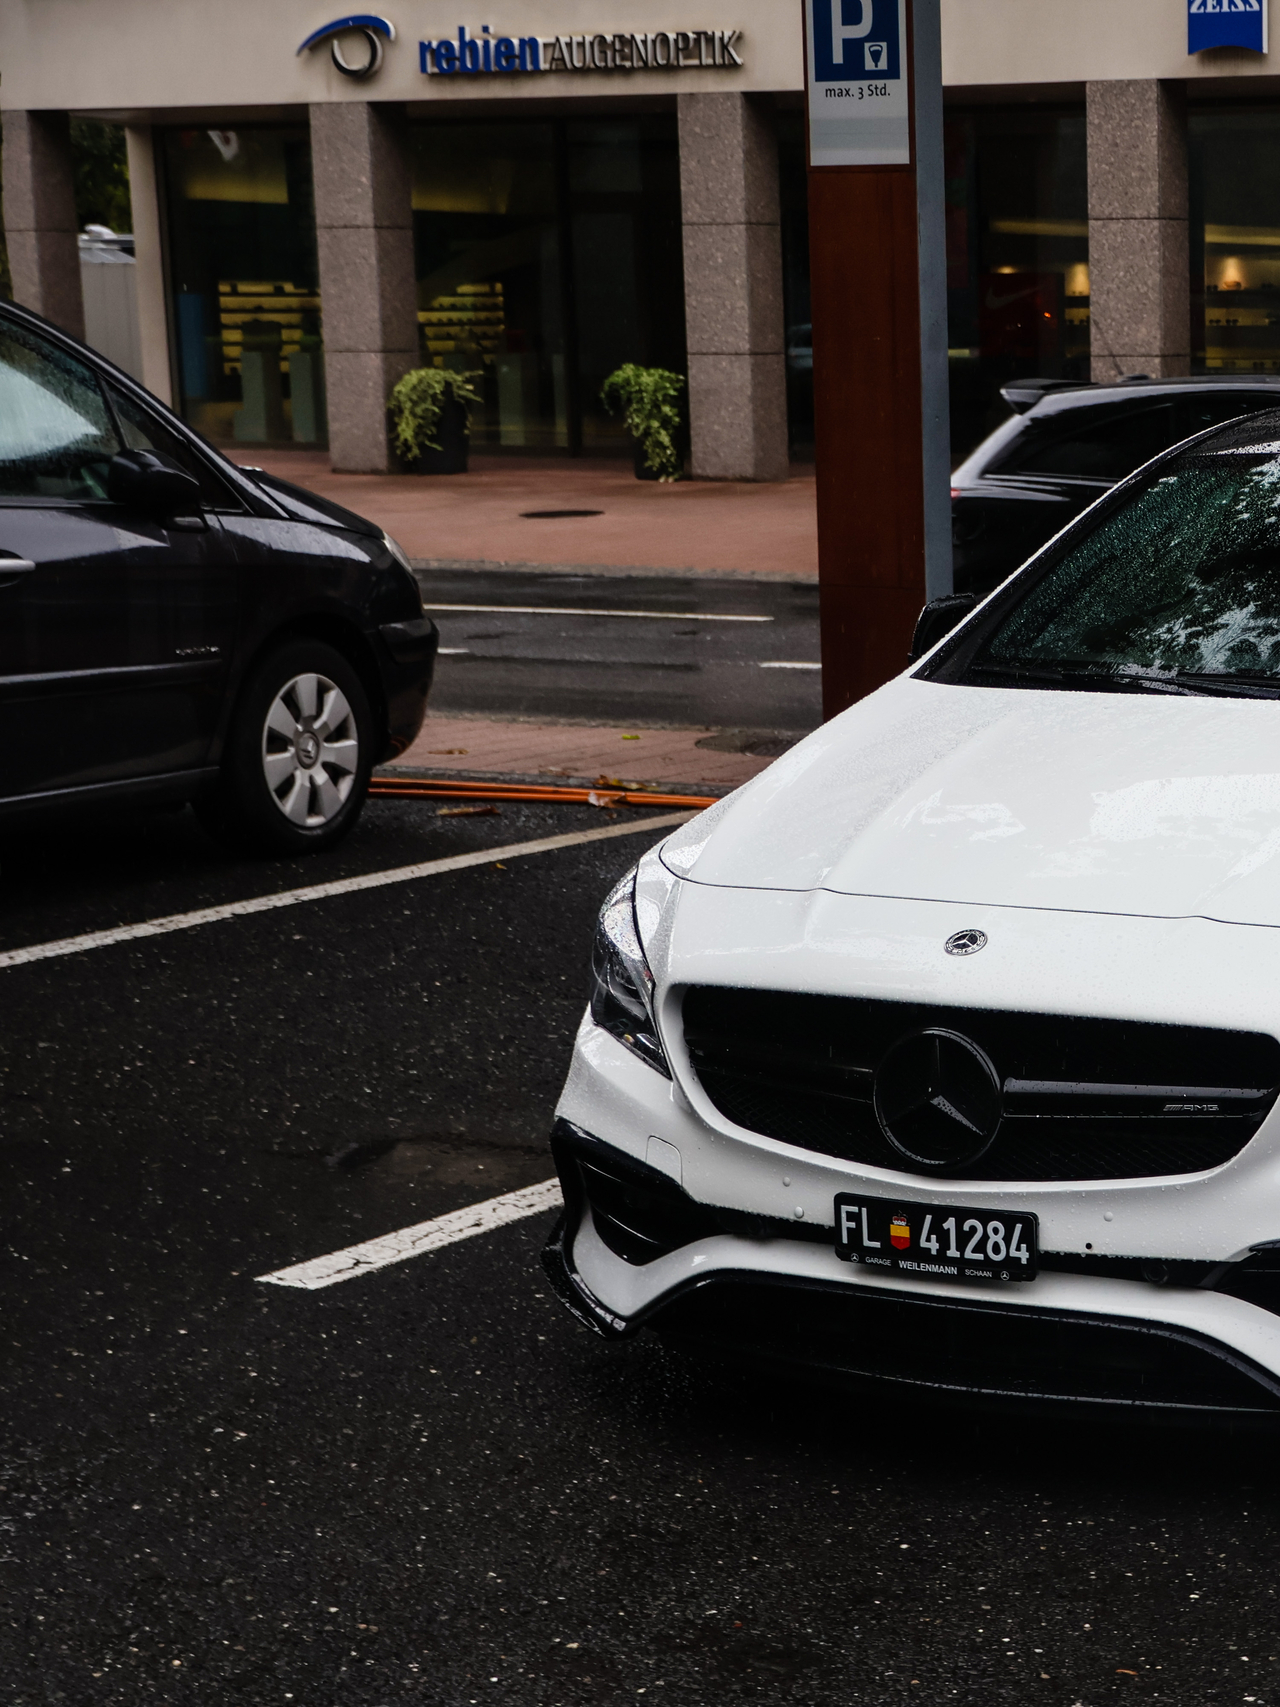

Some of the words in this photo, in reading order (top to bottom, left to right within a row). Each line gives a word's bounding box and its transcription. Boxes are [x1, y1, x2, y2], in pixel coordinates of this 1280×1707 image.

[1190, 0, 1260, 13] ZEISS
[419, 25, 541, 74] rebien
[551, 31, 743, 69] AUGENOPTIK
[831, 0, 873, 64] P
[825, 87, 854, 98] max.
[858, 86, 864, 100] 3
[867, 83, 890, 97] Std.
[840, 1205, 881, 1249] FL
[919, 1214, 1029, 1265] 41284
[865, 1256, 892, 1267] GARAGE
[898, 1260, 958, 1275] WEILENMANN
[964, 1268, 993, 1278] SCHAAN
